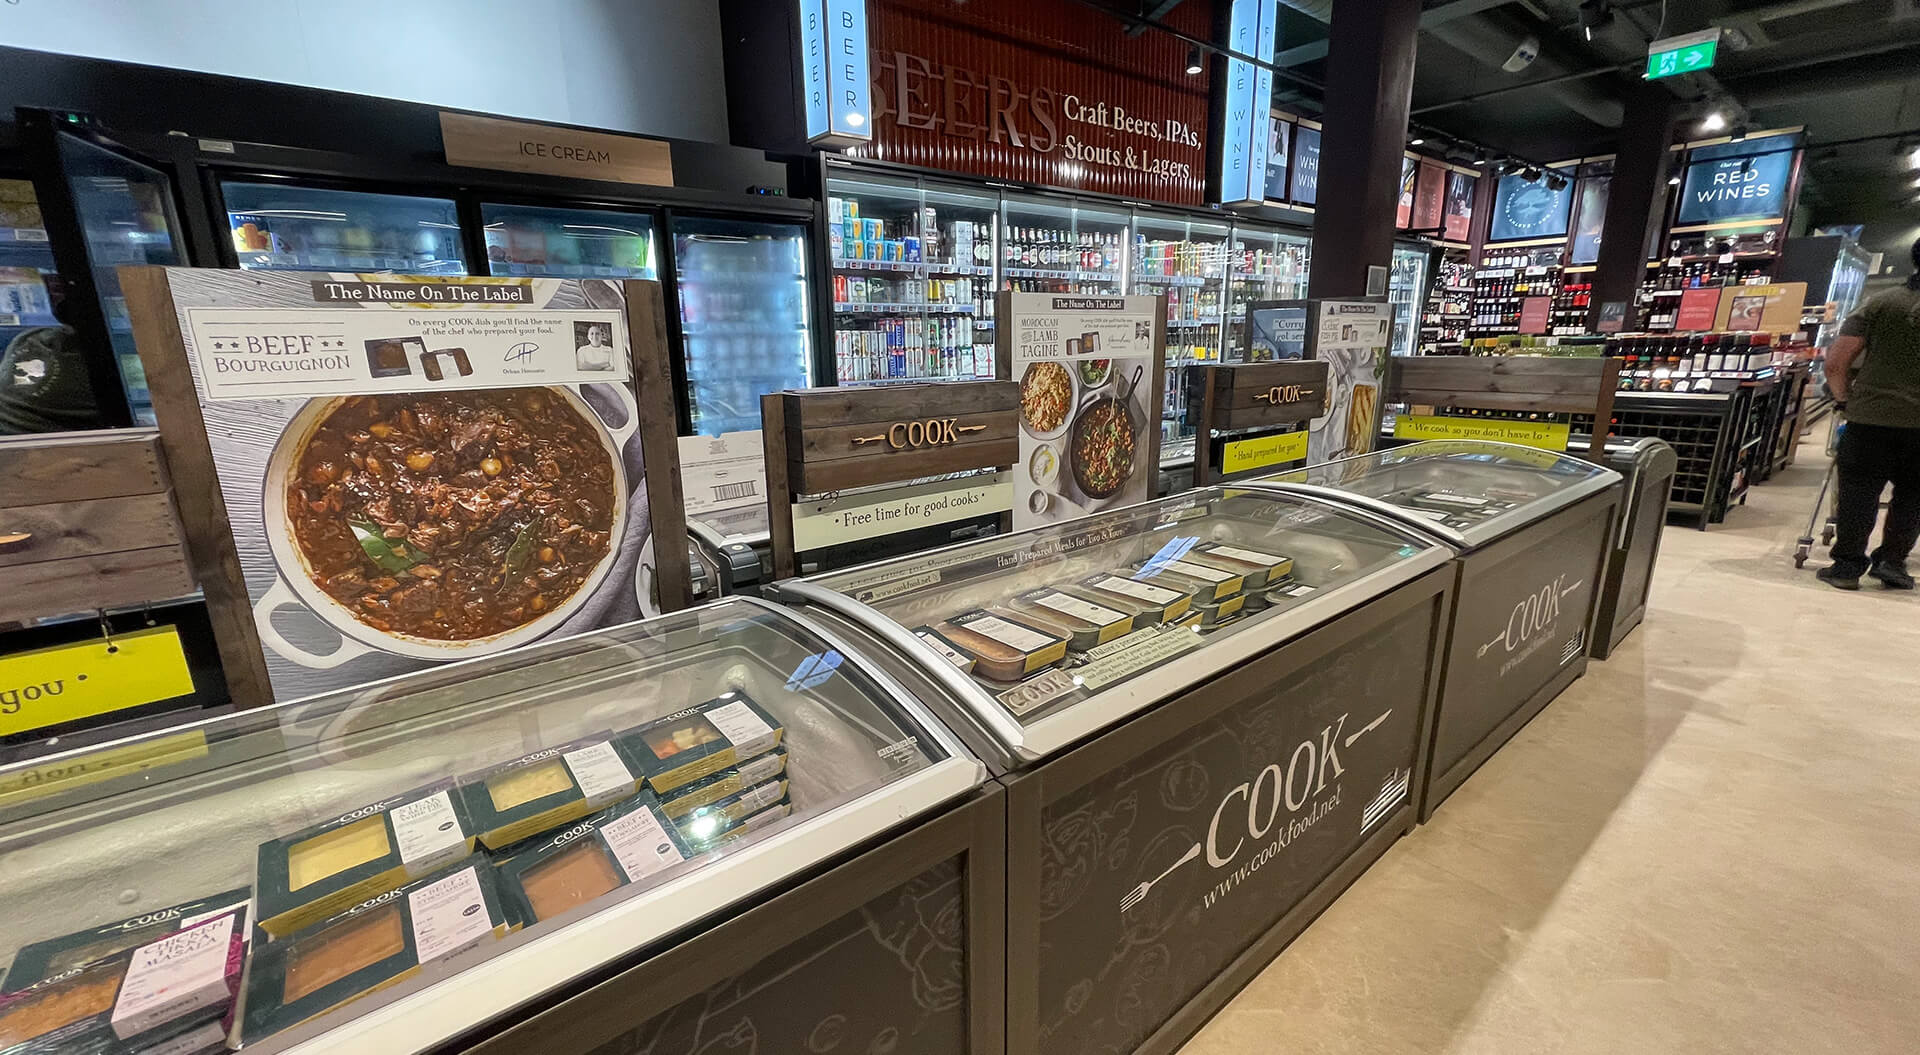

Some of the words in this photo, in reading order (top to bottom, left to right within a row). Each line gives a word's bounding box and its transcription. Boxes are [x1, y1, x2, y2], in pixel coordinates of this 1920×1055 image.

[809, 13, 821, 108] BEER
[842, 11, 857, 107] BEER
[1262, 27, 1270, 90] FIE
[1063, 94, 1108, 128] Craft
[1113, 106, 1162, 141] Beers,
[1165, 120, 1203, 151] IPAs,
[1233, 109, 1246, 170] WINE
[1256, 109, 1266, 169] WINE
[519, 140, 547, 158] ICE
[551, 145, 611, 165] CREAM
[1063, 135, 1121, 168] Stouts
[1124, 146, 1138, 171] &
[1142, 153, 1190, 181] Lagers
[1713, 168, 1759, 186] RED
[1697, 183, 1771, 203] WINES
[324, 283, 363, 300] The
[367, 284, 416, 301] Name
[420, 286, 443, 301] On
[447, 286, 480, 301] The
[484, 286, 523, 301] Label
[408, 318, 421, 326] On
[423, 320, 447, 328] every
[448, 318, 473, 326] COOK
[422, 328, 430, 336] of
[448, 328, 465, 336] chef
[484, 328, 517, 336] prepared
[1021, 318, 1059, 328] MOROCCAN
[245, 334, 315, 356] BEEF
[1033, 330, 1059, 342] LAMB
[1021, 344, 1059, 358] TAGINE
[215, 355, 351, 373] BOURGUIGNON
[1269, 385, 1301, 404] COOK
[889, 418, 958, 448] COOK
[1414, 423, 1430, 432] We
[1430, 423, 1450, 434] cook
[1464, 429, 1481, 438] you
[1482, 427, 1505, 437] don't
[1507, 430, 1531, 439] have
[1533, 431, 1543, 440] to
[843, 510, 872, 527] Free
[875, 507, 901, 521] time
[904, 502, 921, 517] for
[923, 497, 948, 517] good
[950, 492, 979, 507] cooks
[997, 553, 1018, 568] Hand
[1019, 545, 1053, 562] Prepared
[1505, 573, 1566, 652] COOK
[0, 679, 65, 715] you
[1008, 675, 1070, 710] COOK
[666, 707, 698, 722] COOK
[520, 747, 558, 765] COOK
[1206, 712, 1348, 869] COOK
[339, 800, 387, 825] COOK
[553, 820, 595, 846] COOK
[1203, 784, 1343, 909] www.cookfood.net
[349, 887, 404, 916] COOK
[122, 908, 182, 930] COOK
